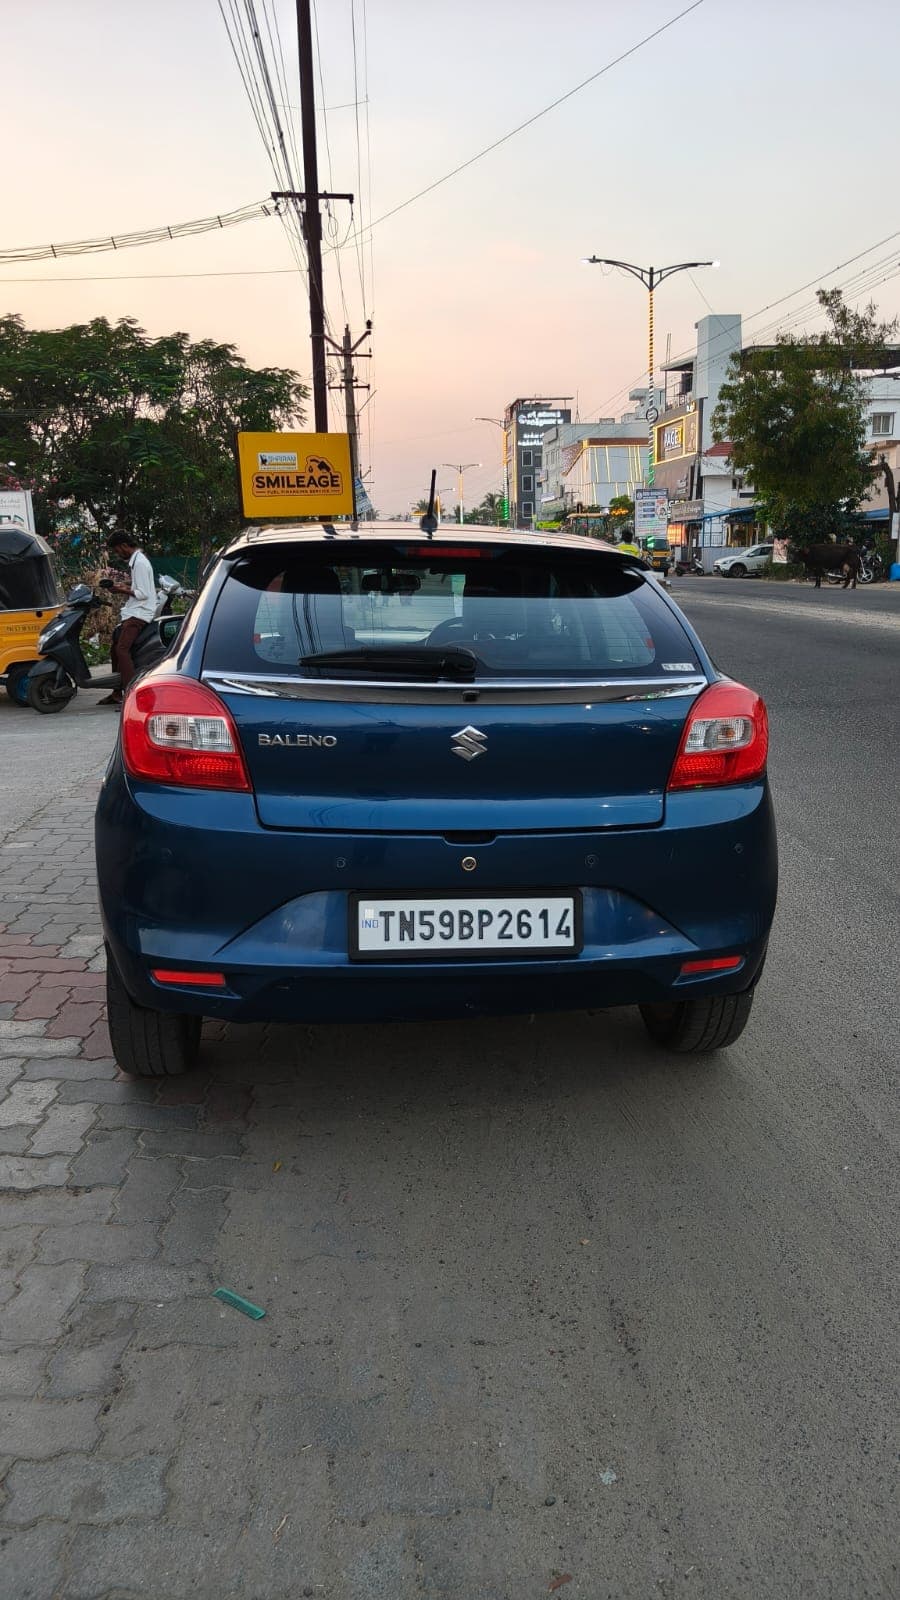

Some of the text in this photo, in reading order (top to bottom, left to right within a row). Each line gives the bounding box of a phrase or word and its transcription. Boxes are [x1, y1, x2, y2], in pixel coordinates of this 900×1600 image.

[255, 475, 340, 489] SMILEAGE
[258, 733, 337, 747] BALENO
[379, 908, 571, 942] TN59BP2614
